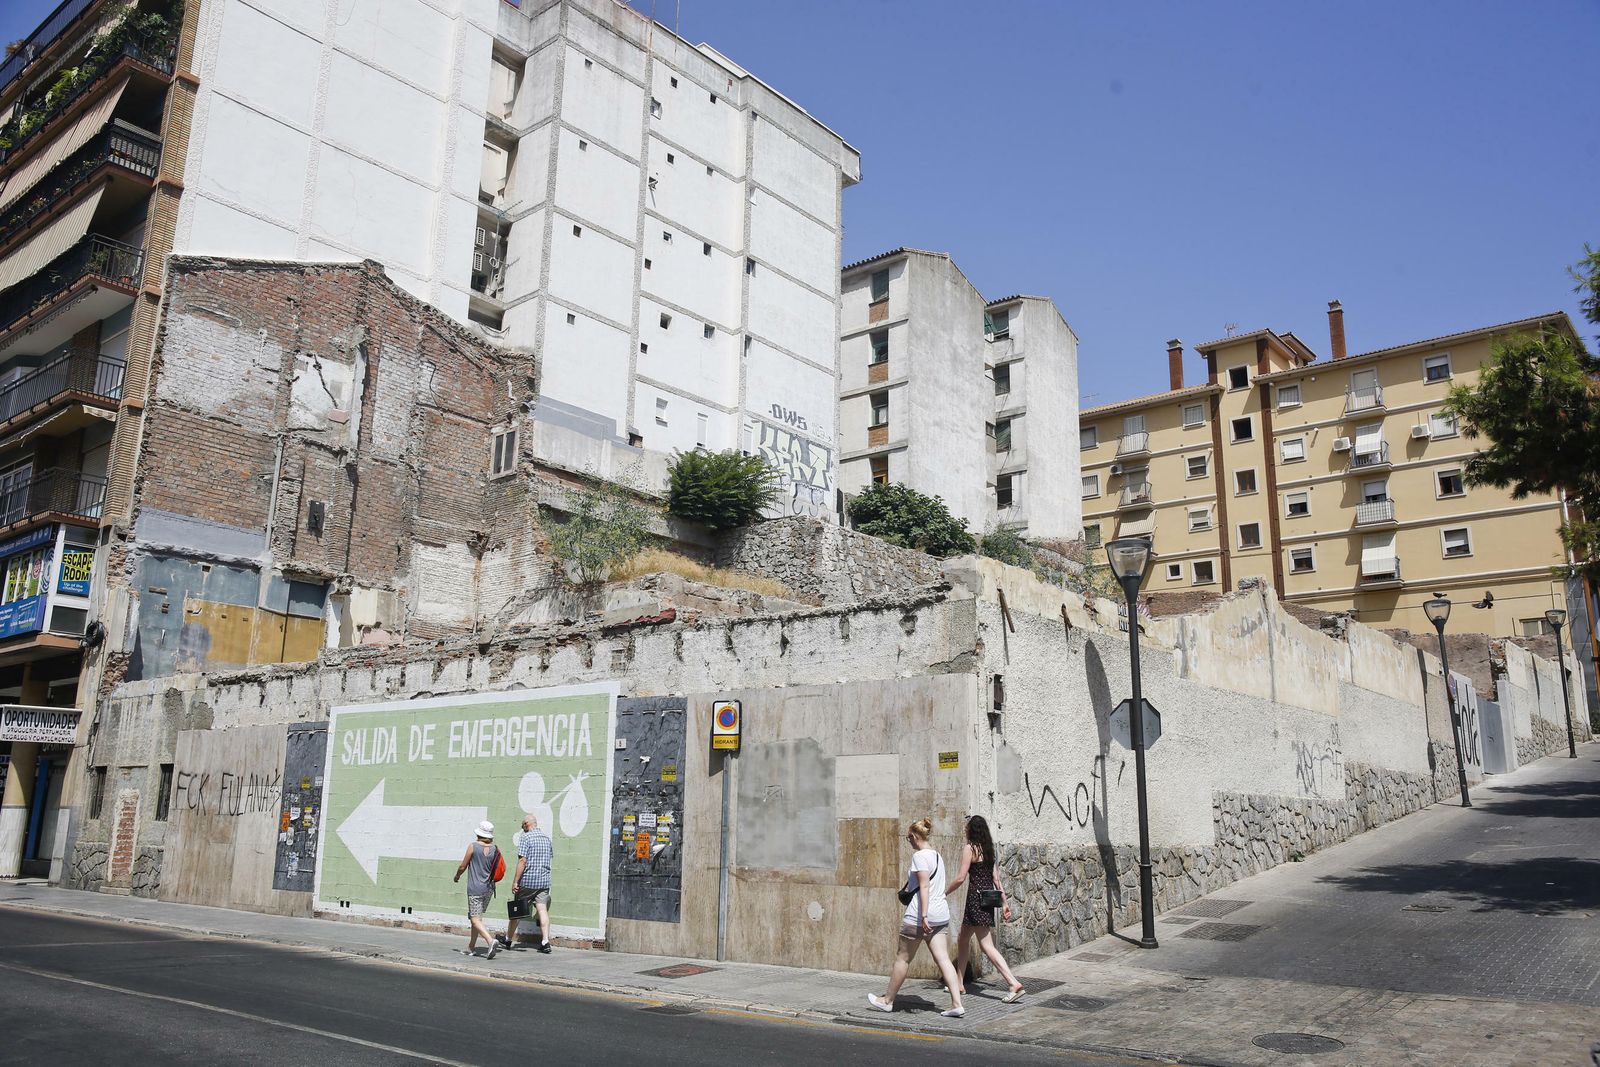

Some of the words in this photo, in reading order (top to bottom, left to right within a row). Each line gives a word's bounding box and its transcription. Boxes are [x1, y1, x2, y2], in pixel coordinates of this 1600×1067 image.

[62, 553, 93, 571] ESCAPE
[63, 565, 90, 581] ROOM
[5, 710, 77, 729] OPORTUNIDADES
[341, 726, 398, 766] SALIDA
[408, 723, 437, 763] DE
[448, 712, 593, 759] EMERGENCIA
[175, 770, 211, 817] FCK
